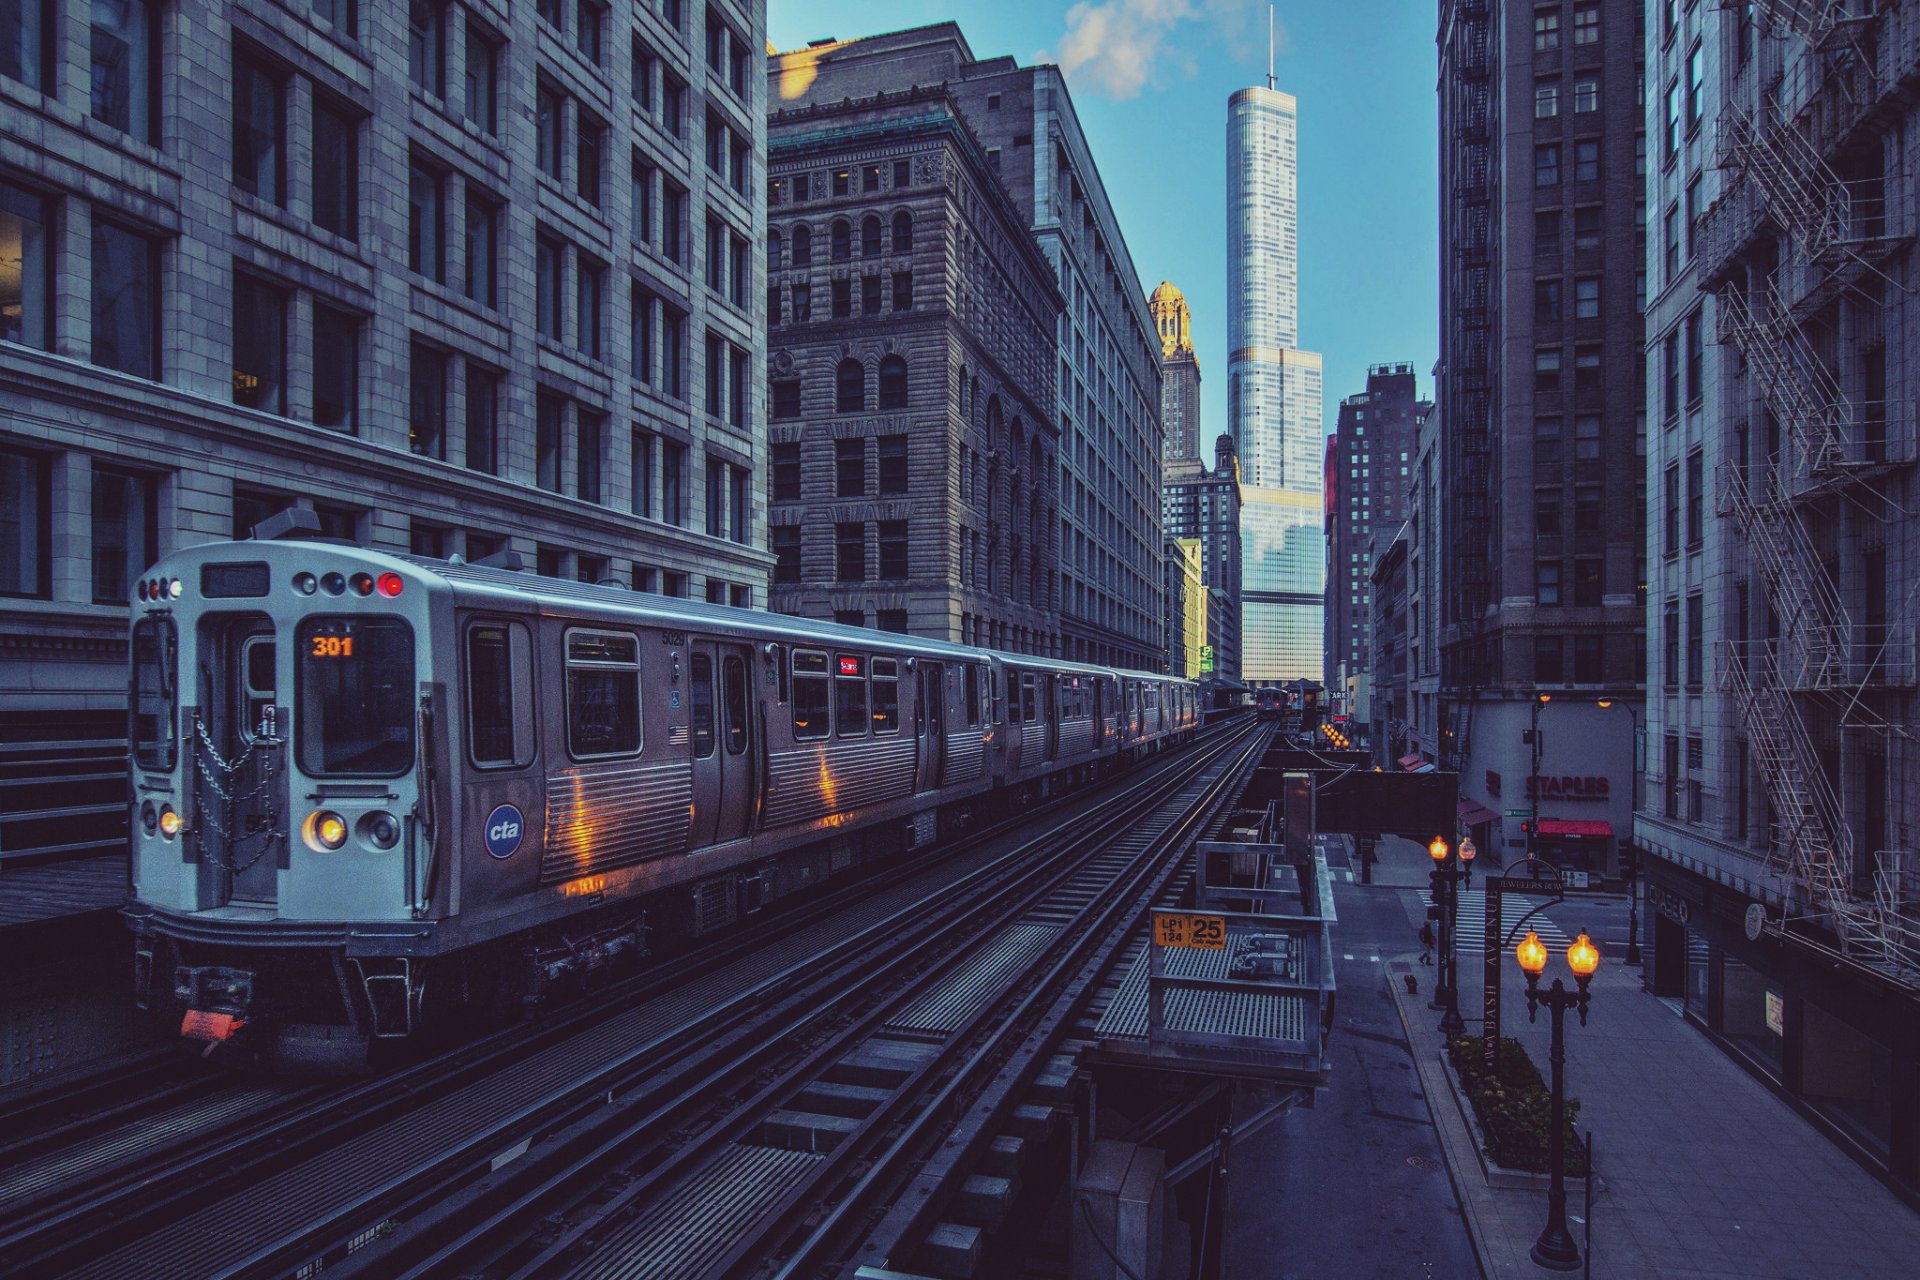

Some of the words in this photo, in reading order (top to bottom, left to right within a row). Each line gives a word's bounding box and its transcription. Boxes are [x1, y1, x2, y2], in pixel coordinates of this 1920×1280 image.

[311, 637, 353, 656] 301
[662, 631, 684, 646] 5029
[1526, 776, 1609, 795] STAPLES
[490, 821, 519, 841] cta
[1500, 880, 1543, 889] JEWELERS
[1544, 882, 1562, 890] ROW
[1162, 932, 1183, 942] 124
[1194, 919, 1221, 938] 25
[1486, 891, 1498, 967] AVENUE
[1484, 985, 1497, 1060] WABASH
